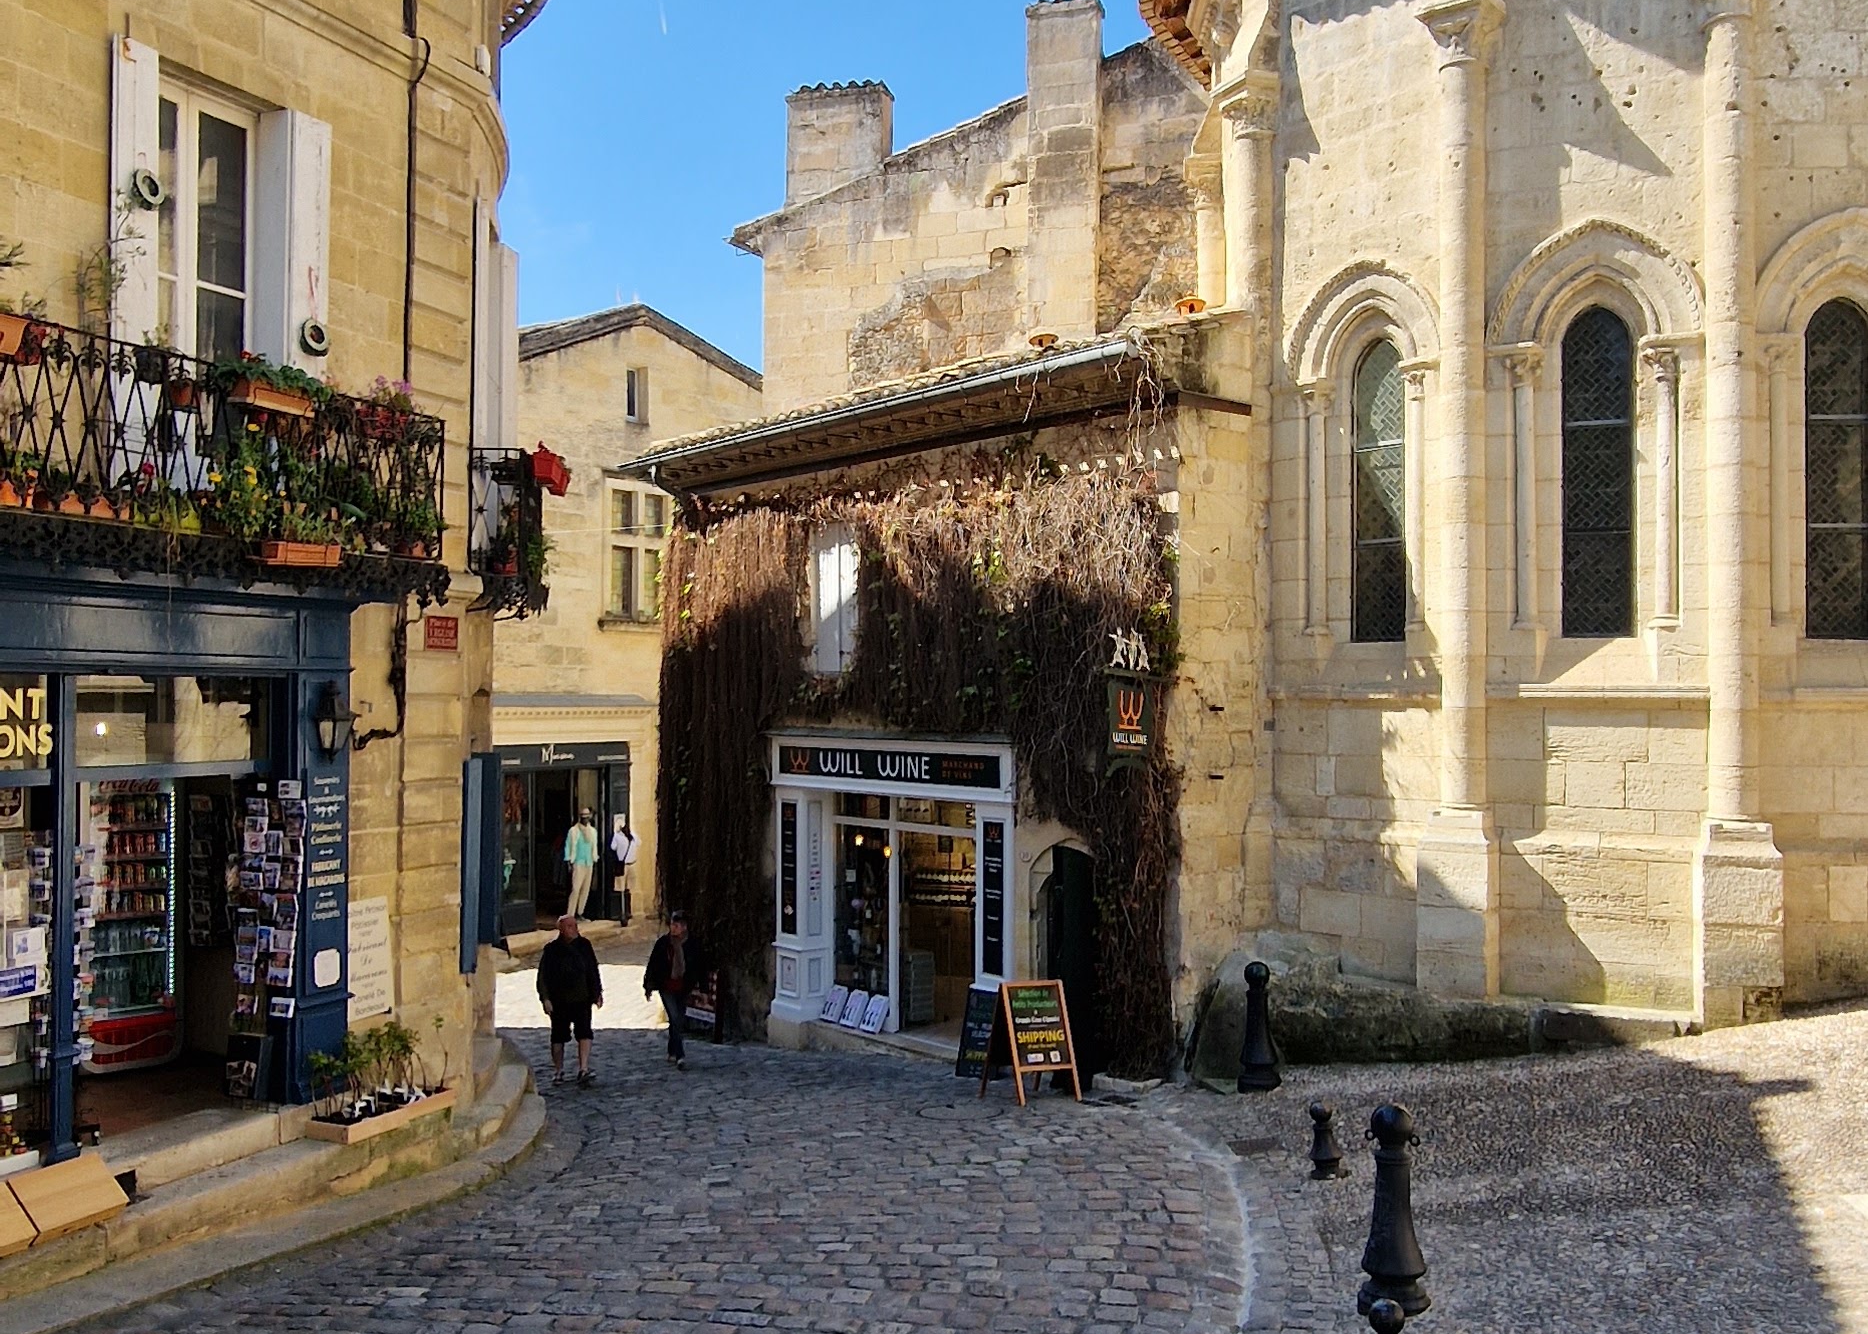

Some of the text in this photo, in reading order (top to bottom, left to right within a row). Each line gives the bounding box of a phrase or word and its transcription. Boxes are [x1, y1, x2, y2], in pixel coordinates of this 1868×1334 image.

[1112, 732, 1148, 746] WILL WINE
[819, 750, 930, 779] WILL WINE
[1017, 1029, 1065, 1043] SHIPPING
